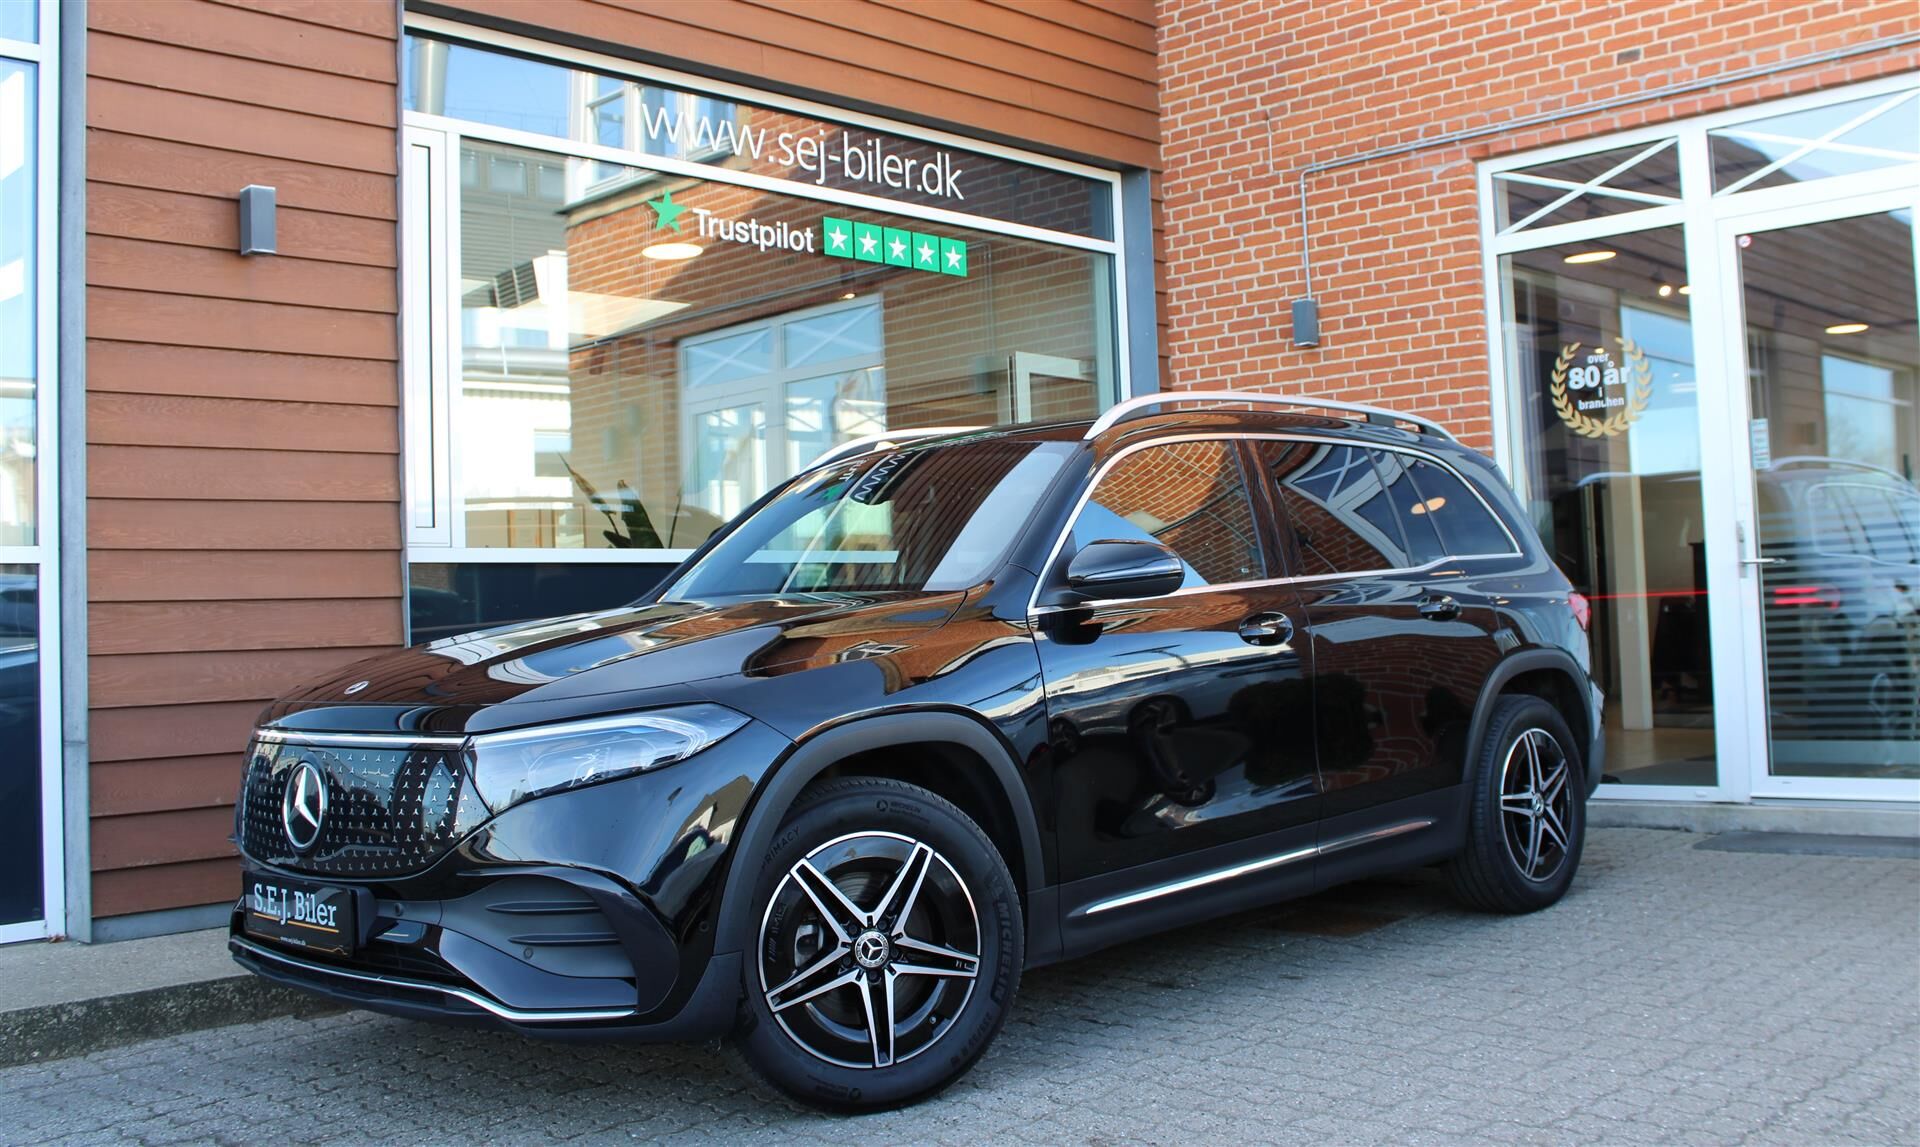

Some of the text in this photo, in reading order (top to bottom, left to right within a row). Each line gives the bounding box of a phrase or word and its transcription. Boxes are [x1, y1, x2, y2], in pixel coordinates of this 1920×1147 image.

[642, 103, 965, 200] www.sej-biler.dk
[693, 207, 815, 254] Trustpilot
[1568, 361, 1631, 390] 80 år
[1587, 353, 1610, 364] over
[1577, 397, 1625, 411] branchen
[253, 883, 337, 927] S.E.J. Biler
